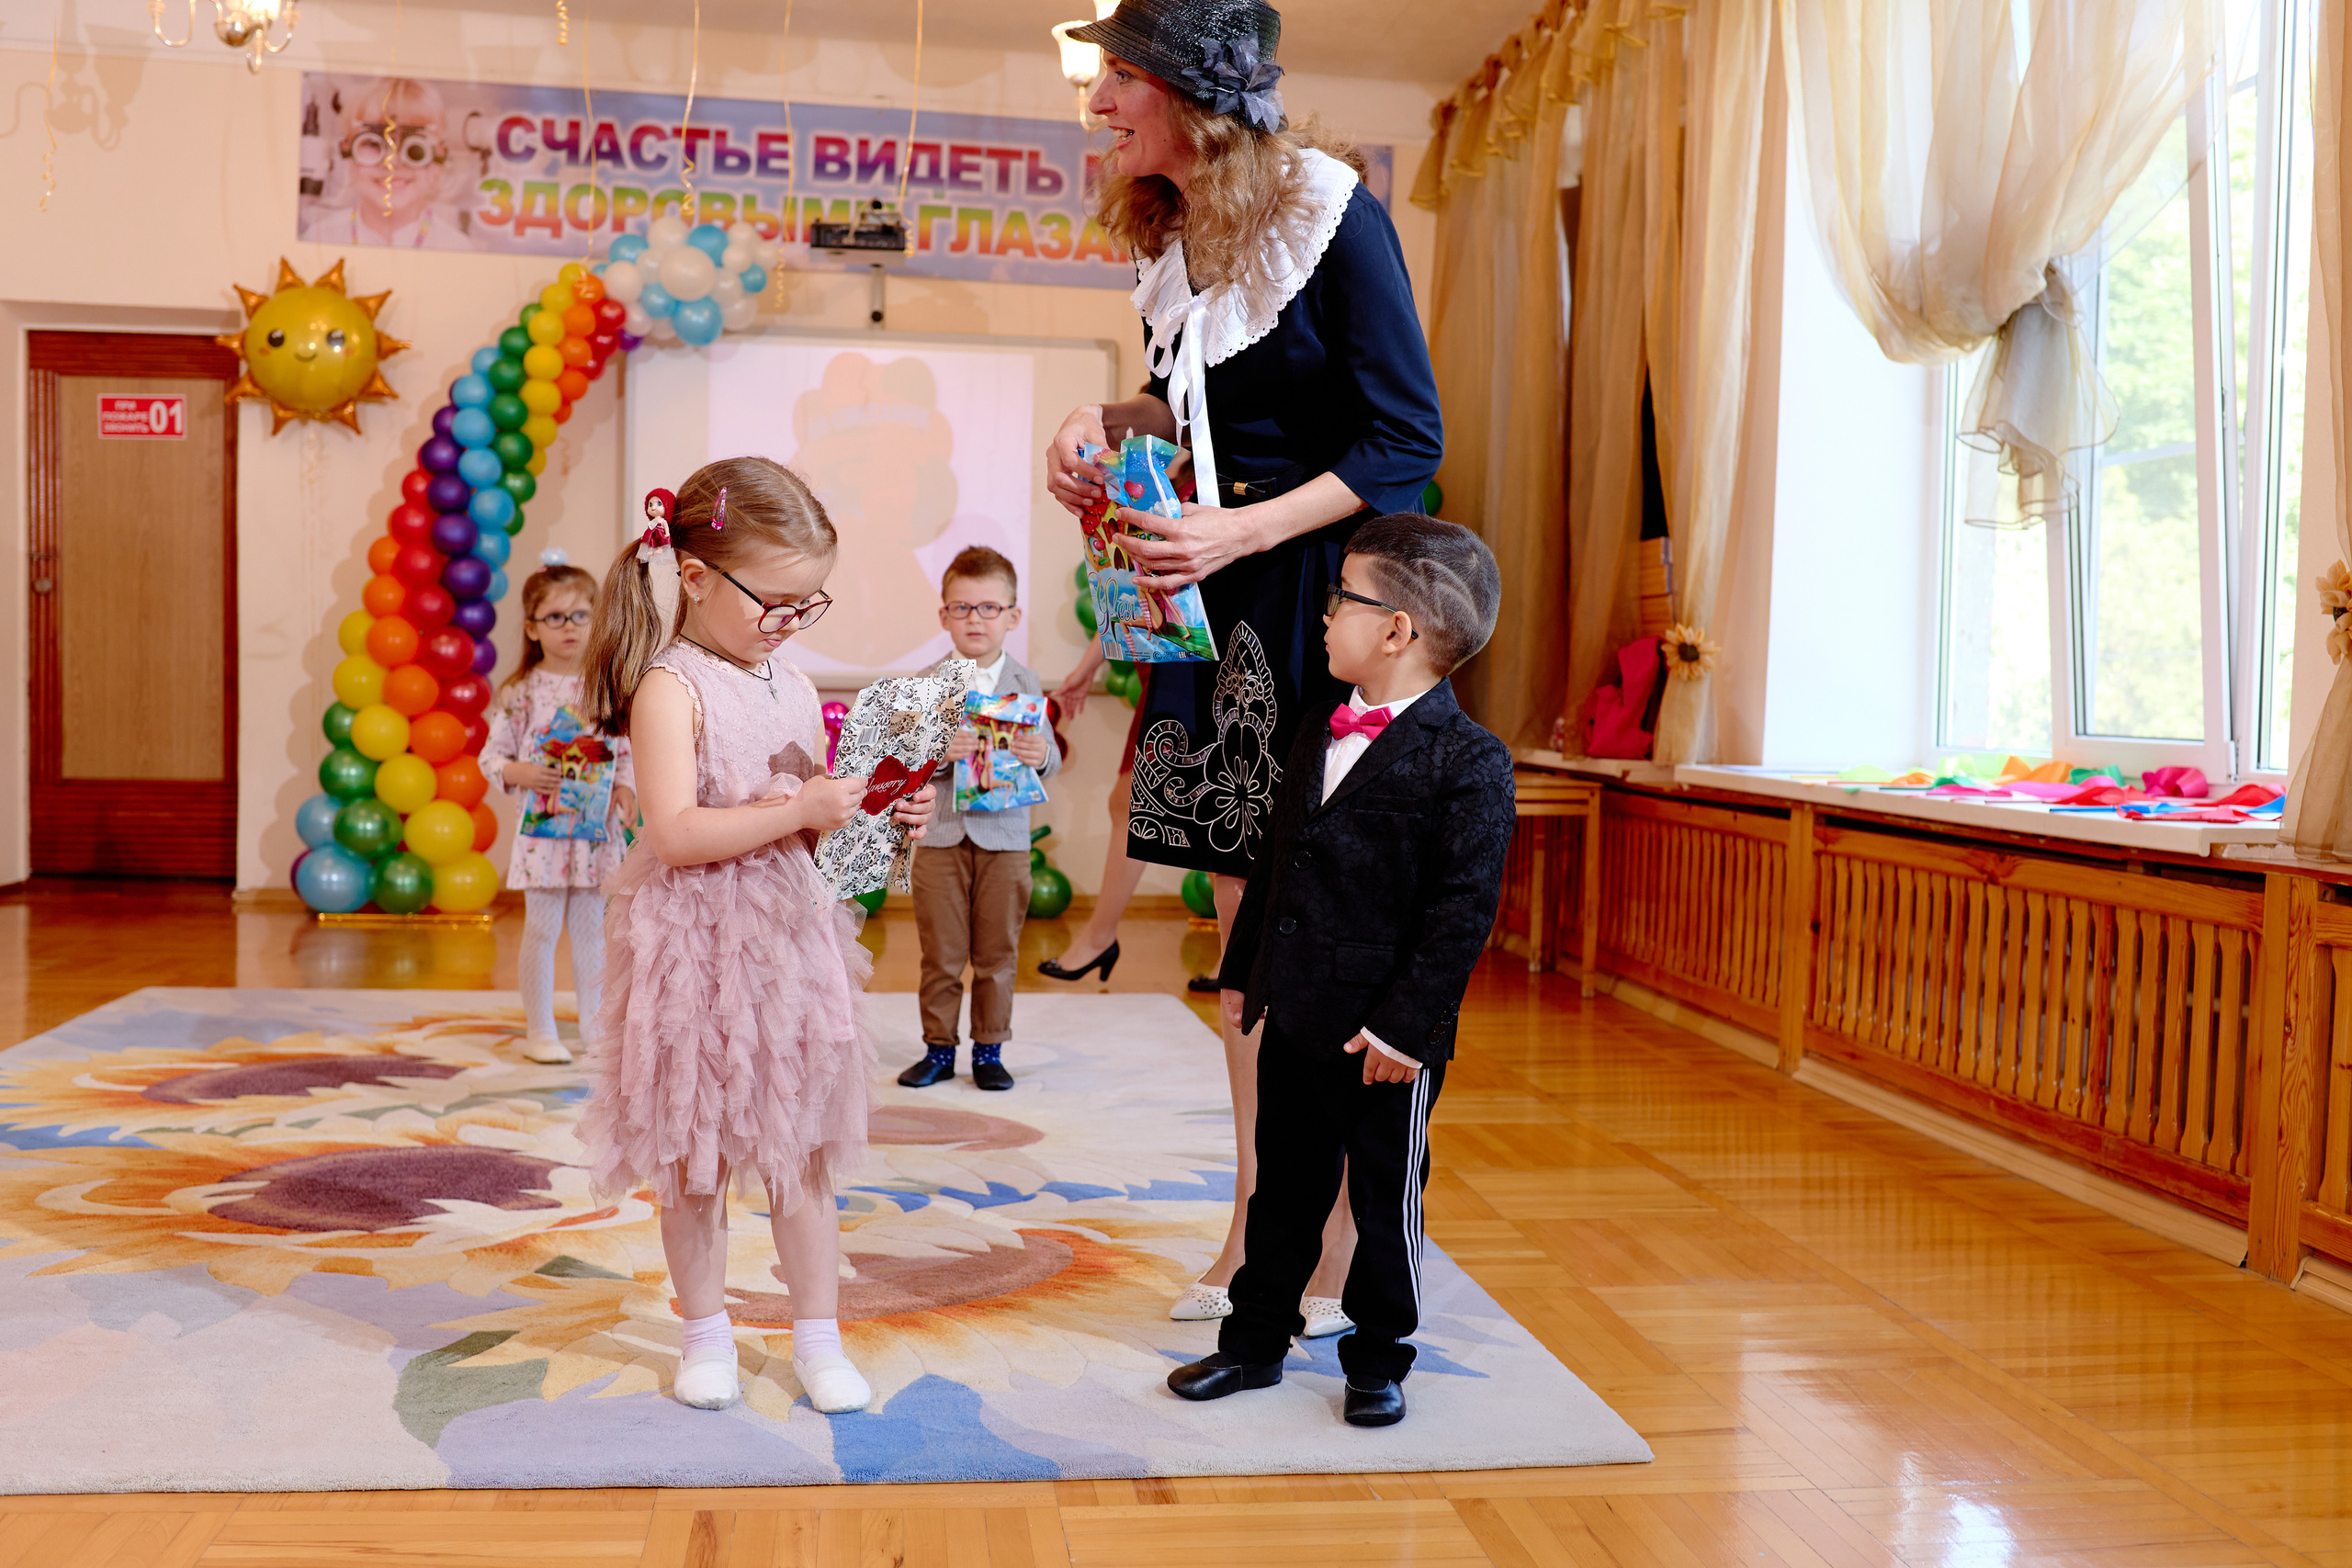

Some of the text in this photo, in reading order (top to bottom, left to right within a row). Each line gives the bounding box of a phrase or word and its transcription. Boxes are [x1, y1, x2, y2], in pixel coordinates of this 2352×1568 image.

[497, 116, 791, 178] СЧАСТЬЕ
[813, 136, 1063, 196] ВИДЕТЬ
[918, 204, 1128, 264] ГЛАЗА
[149, 400, 183, 434] 01
